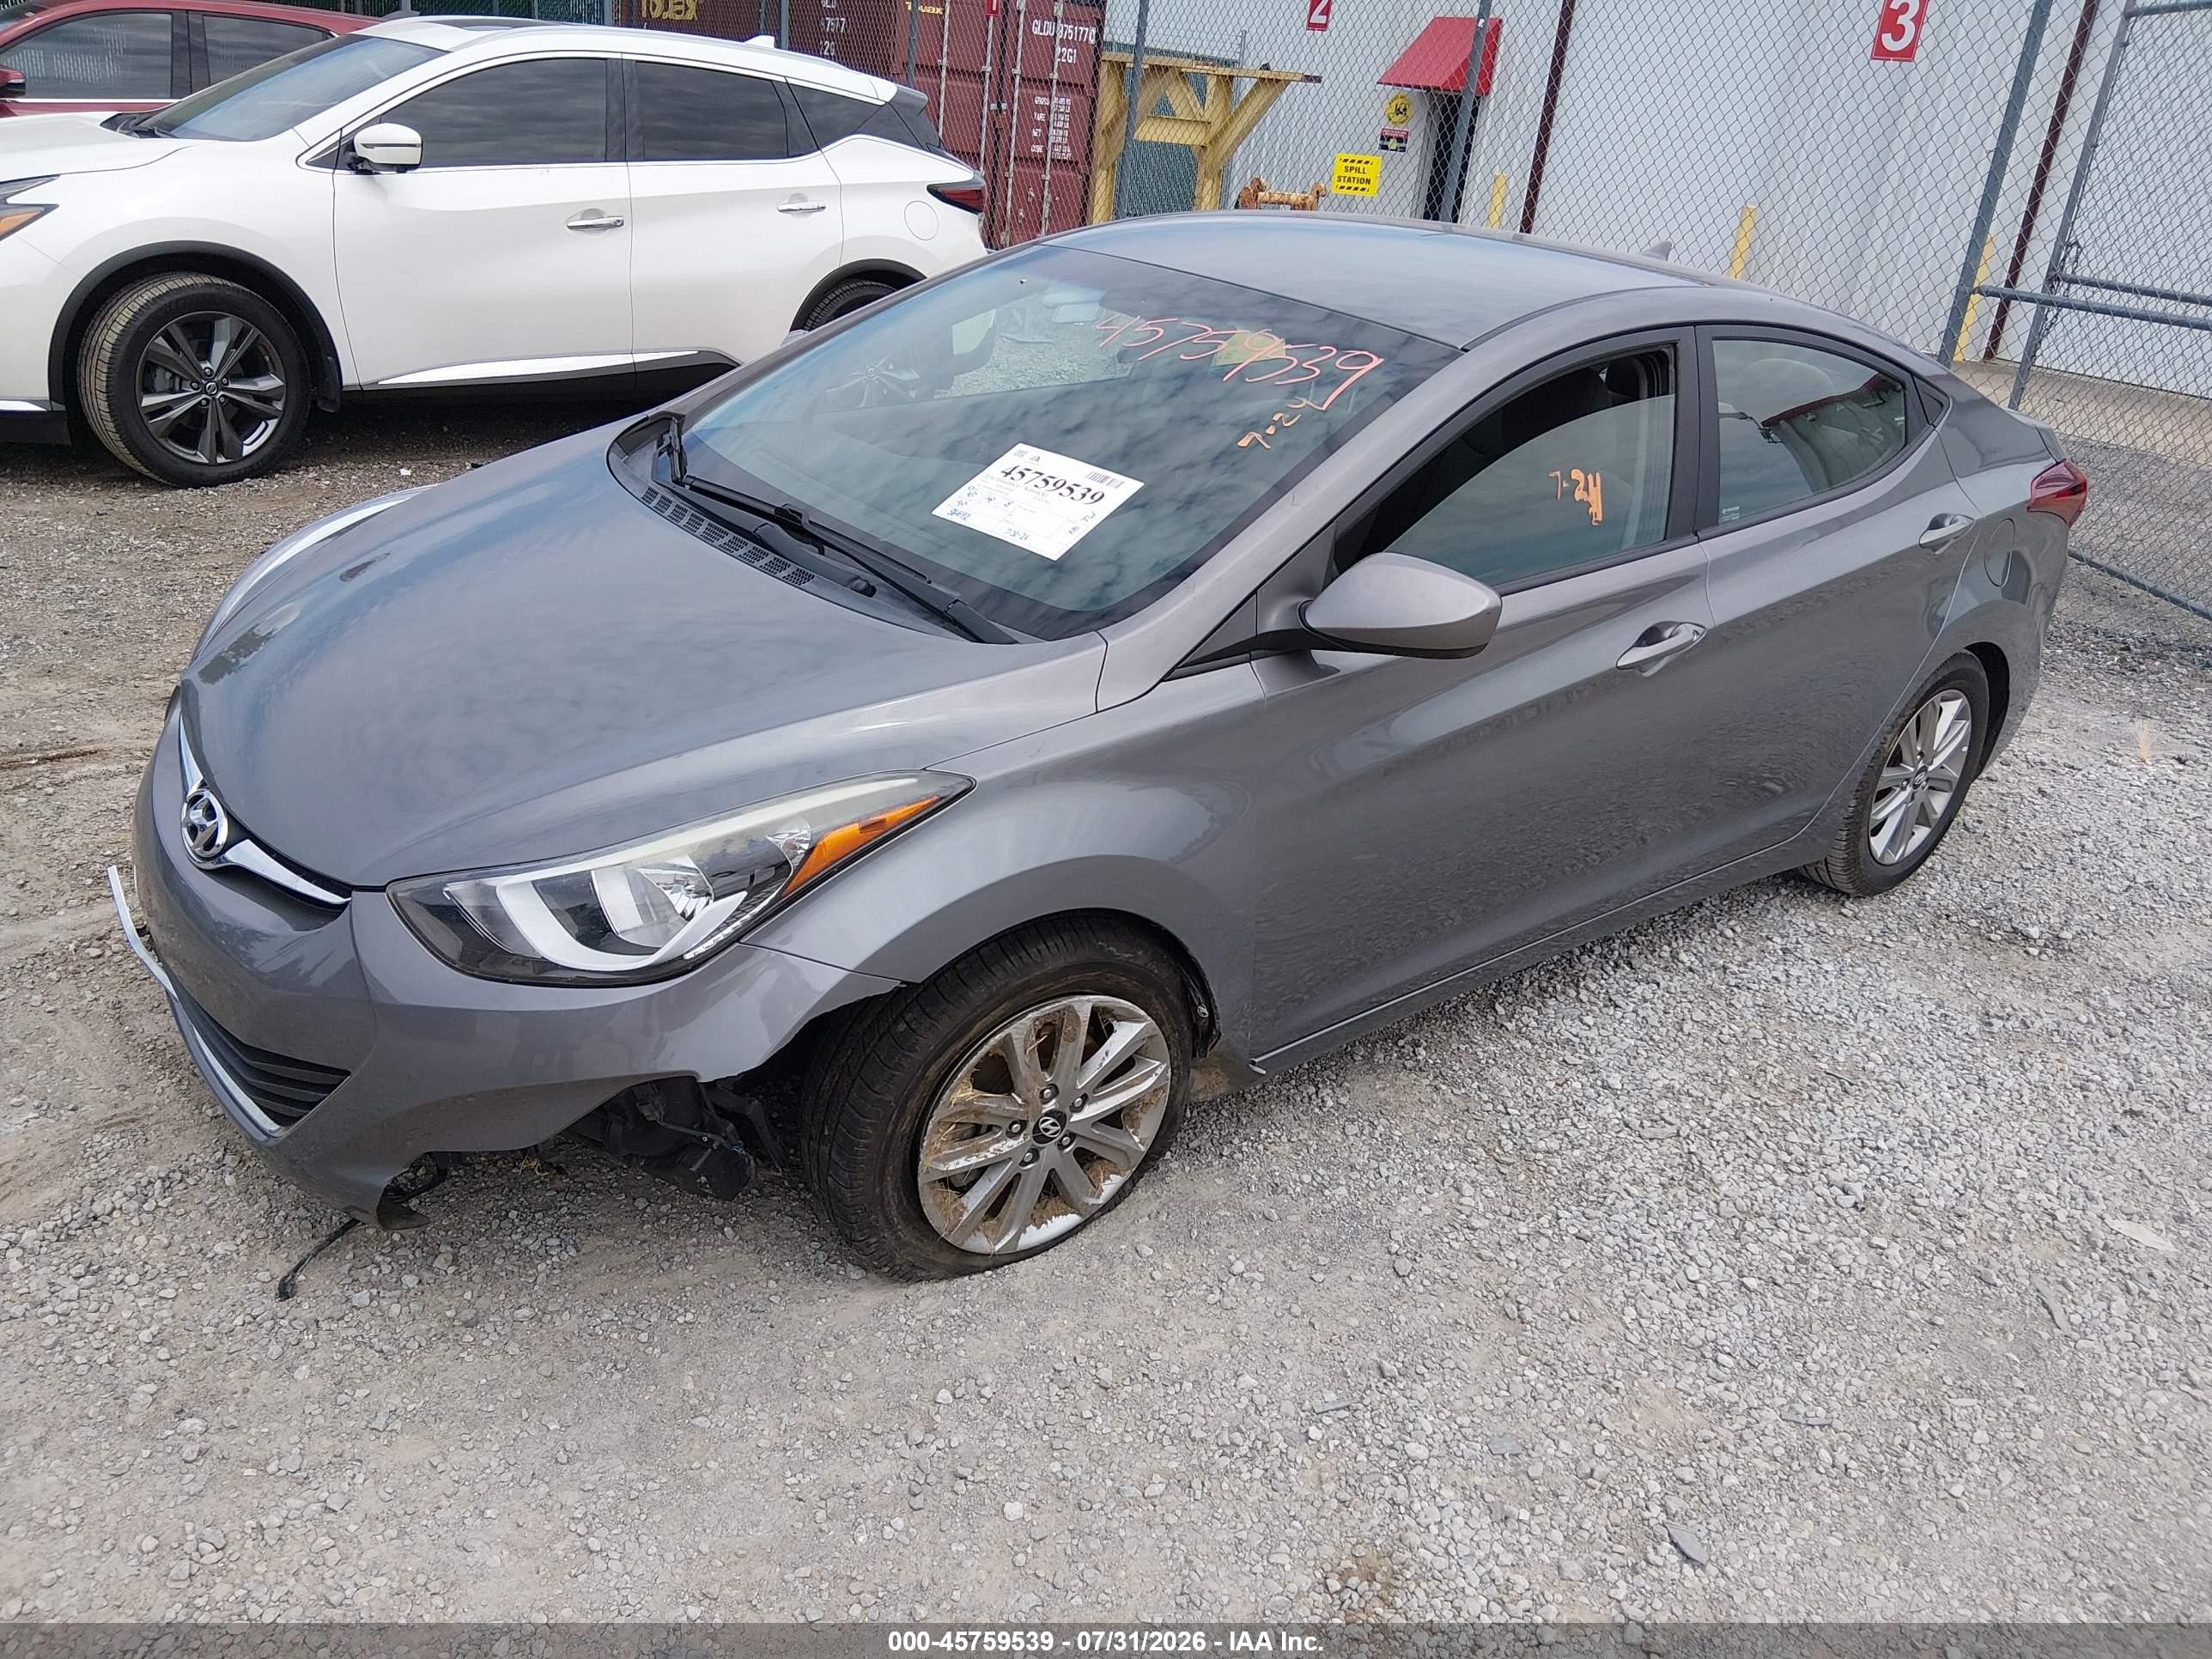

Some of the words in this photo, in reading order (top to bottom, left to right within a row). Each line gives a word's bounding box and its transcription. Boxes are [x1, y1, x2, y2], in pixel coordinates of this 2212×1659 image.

[1881, 0, 1920, 52] 3
[1336, 175, 1371, 185] STATION
[1344, 165, 1367, 174] SPILL
[1095, 313, 1384, 411] 45759539
[1000, 465, 1105, 505] 45759539
